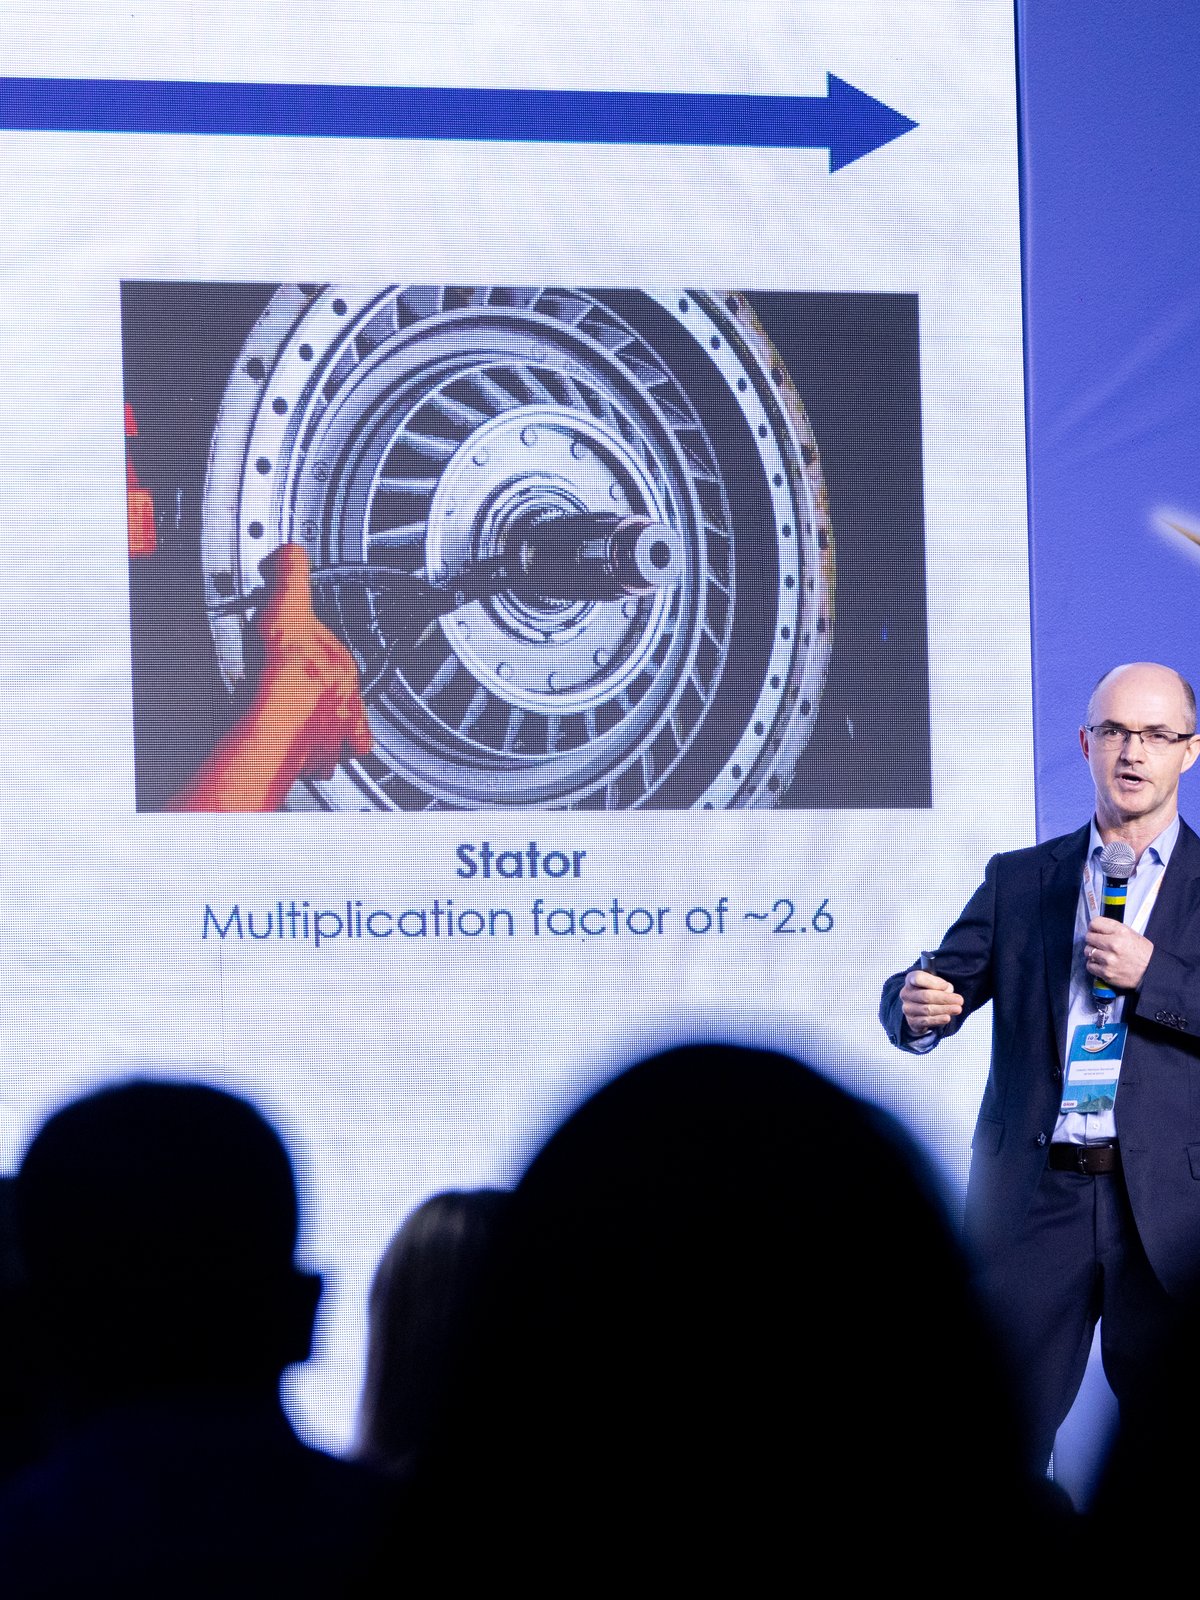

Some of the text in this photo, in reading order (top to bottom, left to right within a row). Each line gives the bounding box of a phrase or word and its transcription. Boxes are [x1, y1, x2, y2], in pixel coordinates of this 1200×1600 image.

[455, 841, 586, 879] Stator
[201, 898, 835, 948] Multiplication factor of ~2.6
